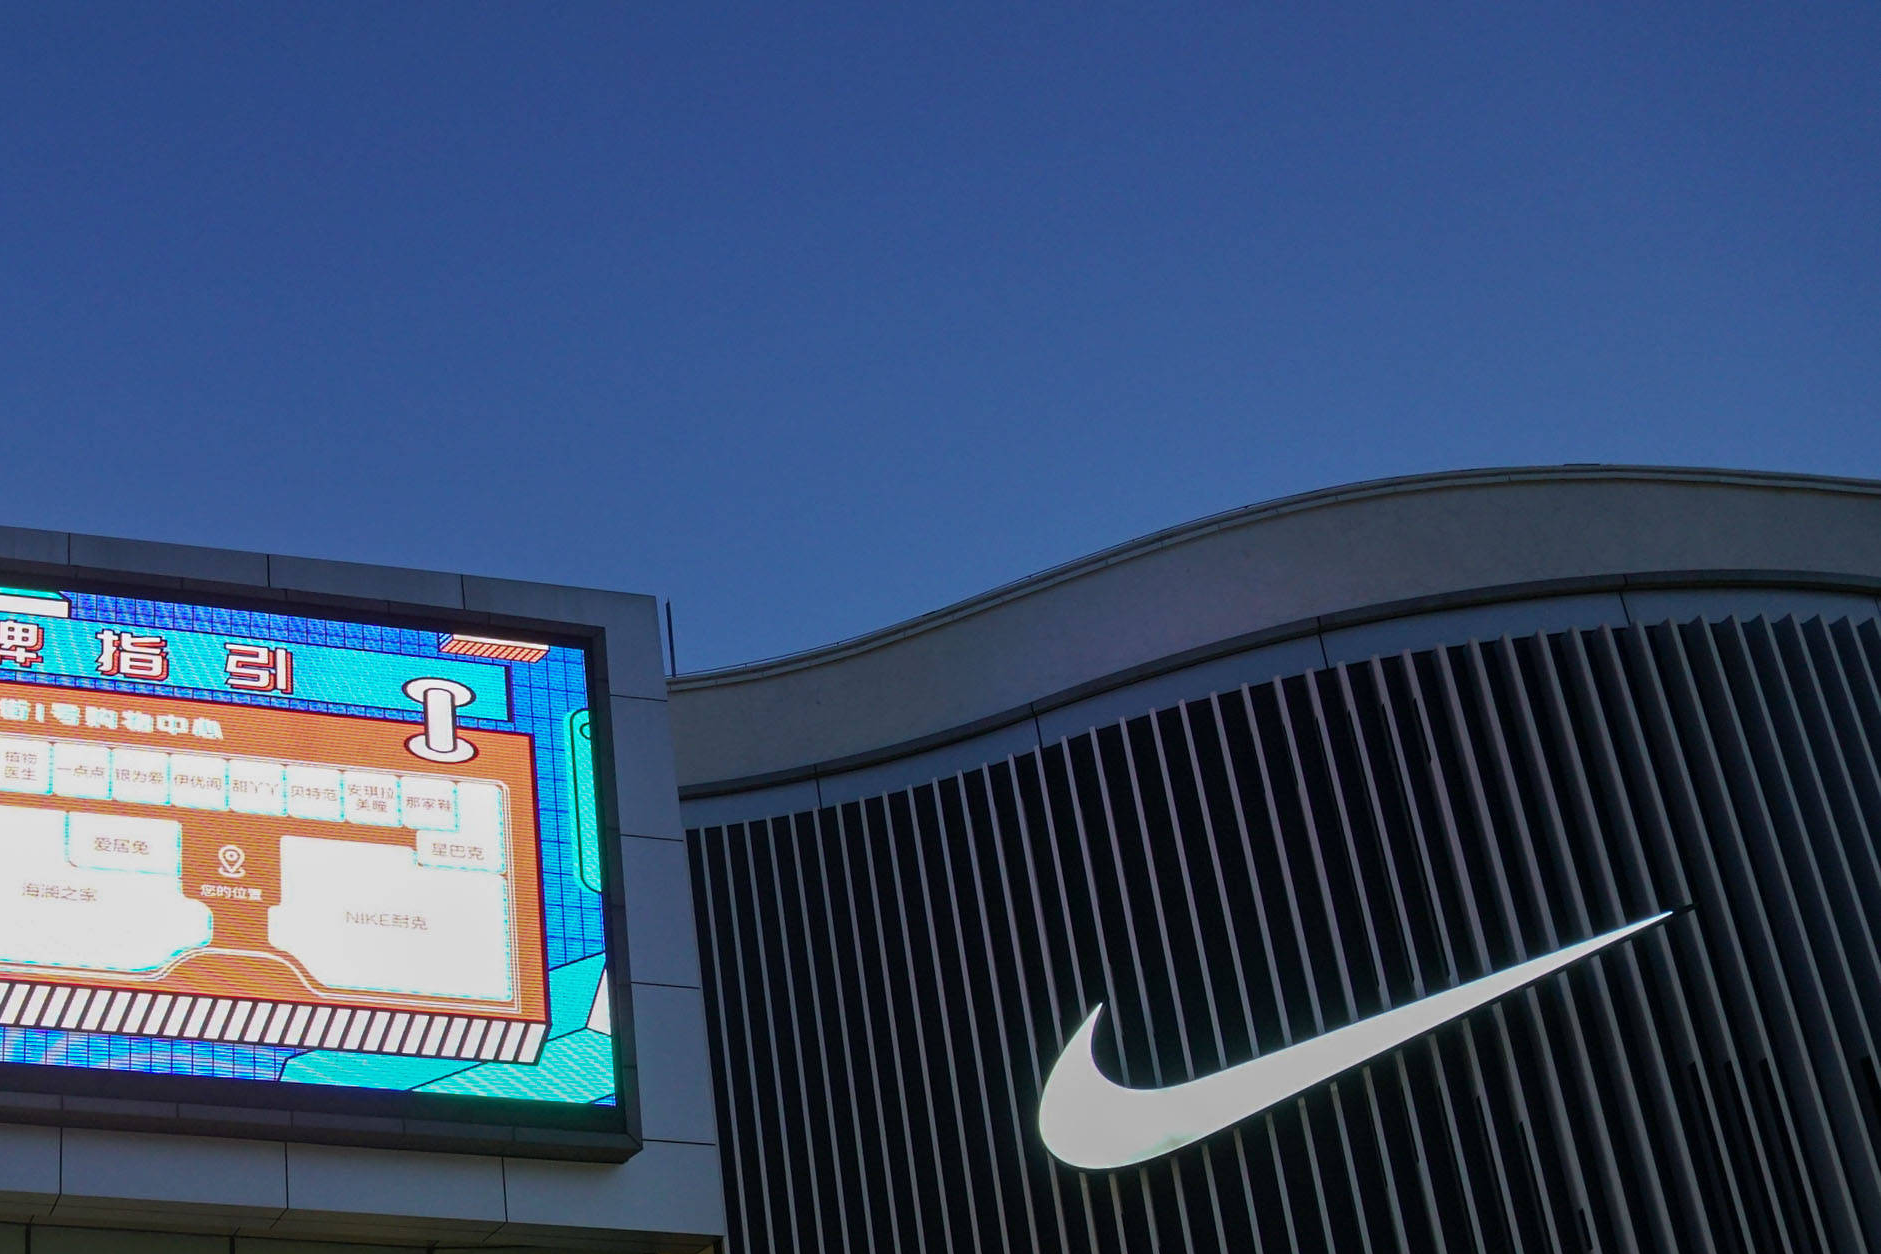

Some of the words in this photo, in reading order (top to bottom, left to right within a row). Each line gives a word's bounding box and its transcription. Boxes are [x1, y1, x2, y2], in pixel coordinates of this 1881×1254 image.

[4, 765, 38, 781] 医生
[56, 764, 105, 779] 一点点
[94, 836, 150, 856] 爱居兔
[431, 842, 485, 861] 星巴克
[22, 882, 97, 902] 海澜之家
[200, 884, 263, 901] 您的位置
